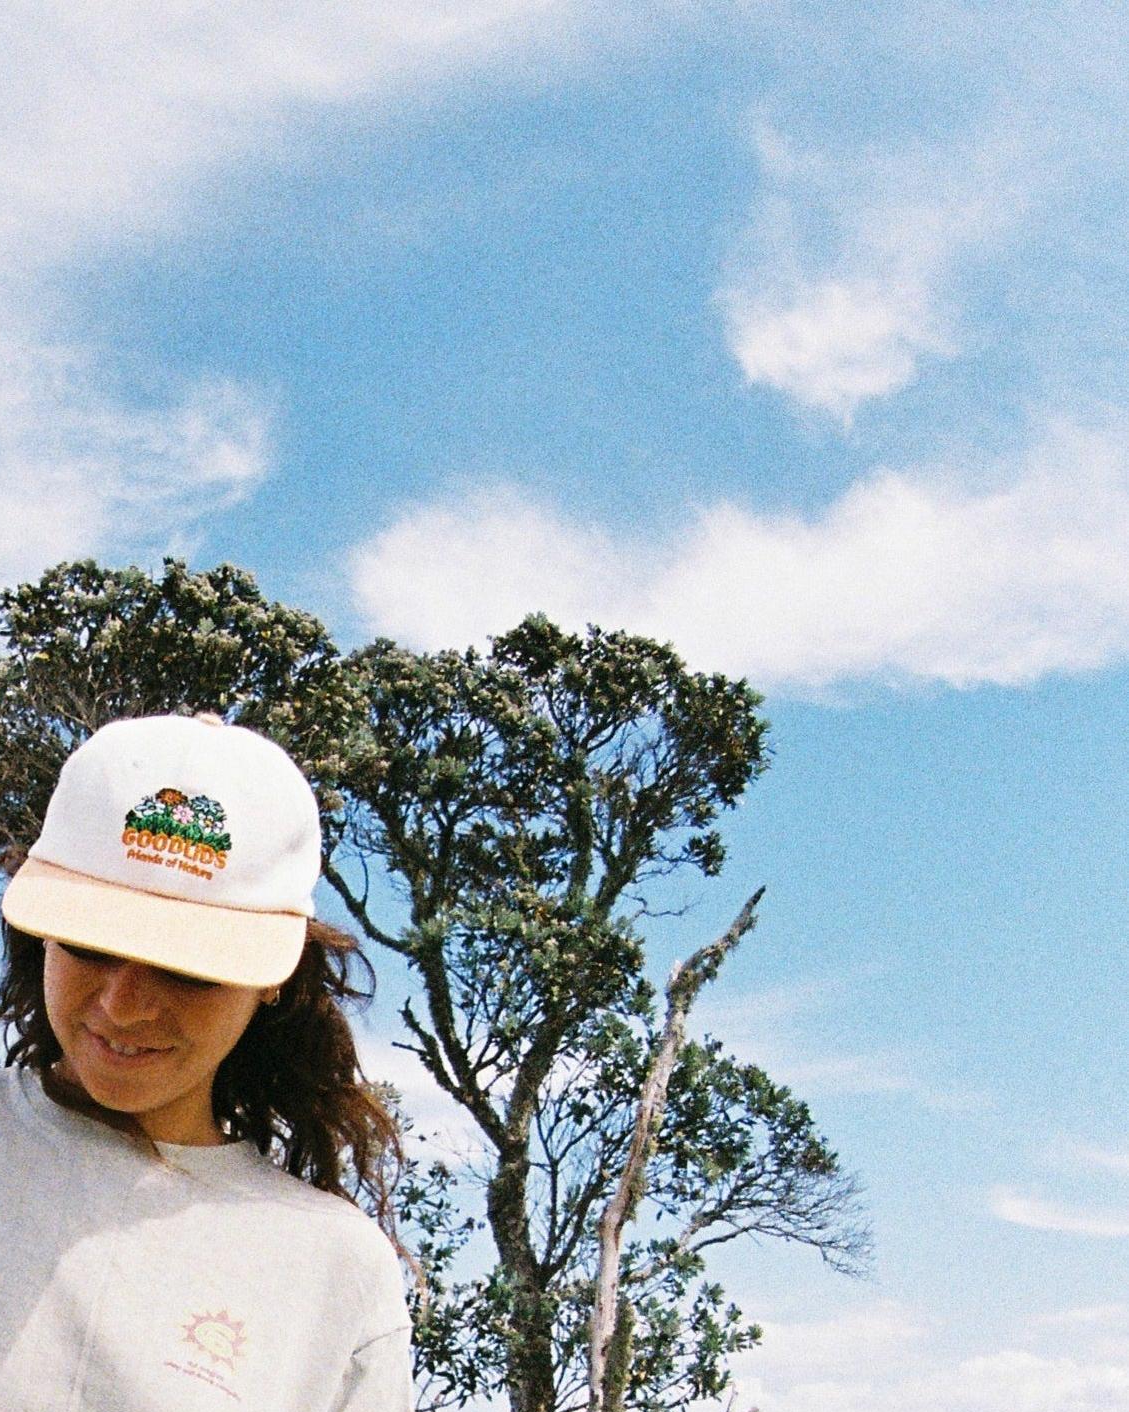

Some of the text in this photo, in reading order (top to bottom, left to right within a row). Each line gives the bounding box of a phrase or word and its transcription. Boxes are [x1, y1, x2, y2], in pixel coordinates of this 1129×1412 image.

[122, 828, 227, 869] GOODLIDS
[127, 849, 213, 880] Friends of Nature
